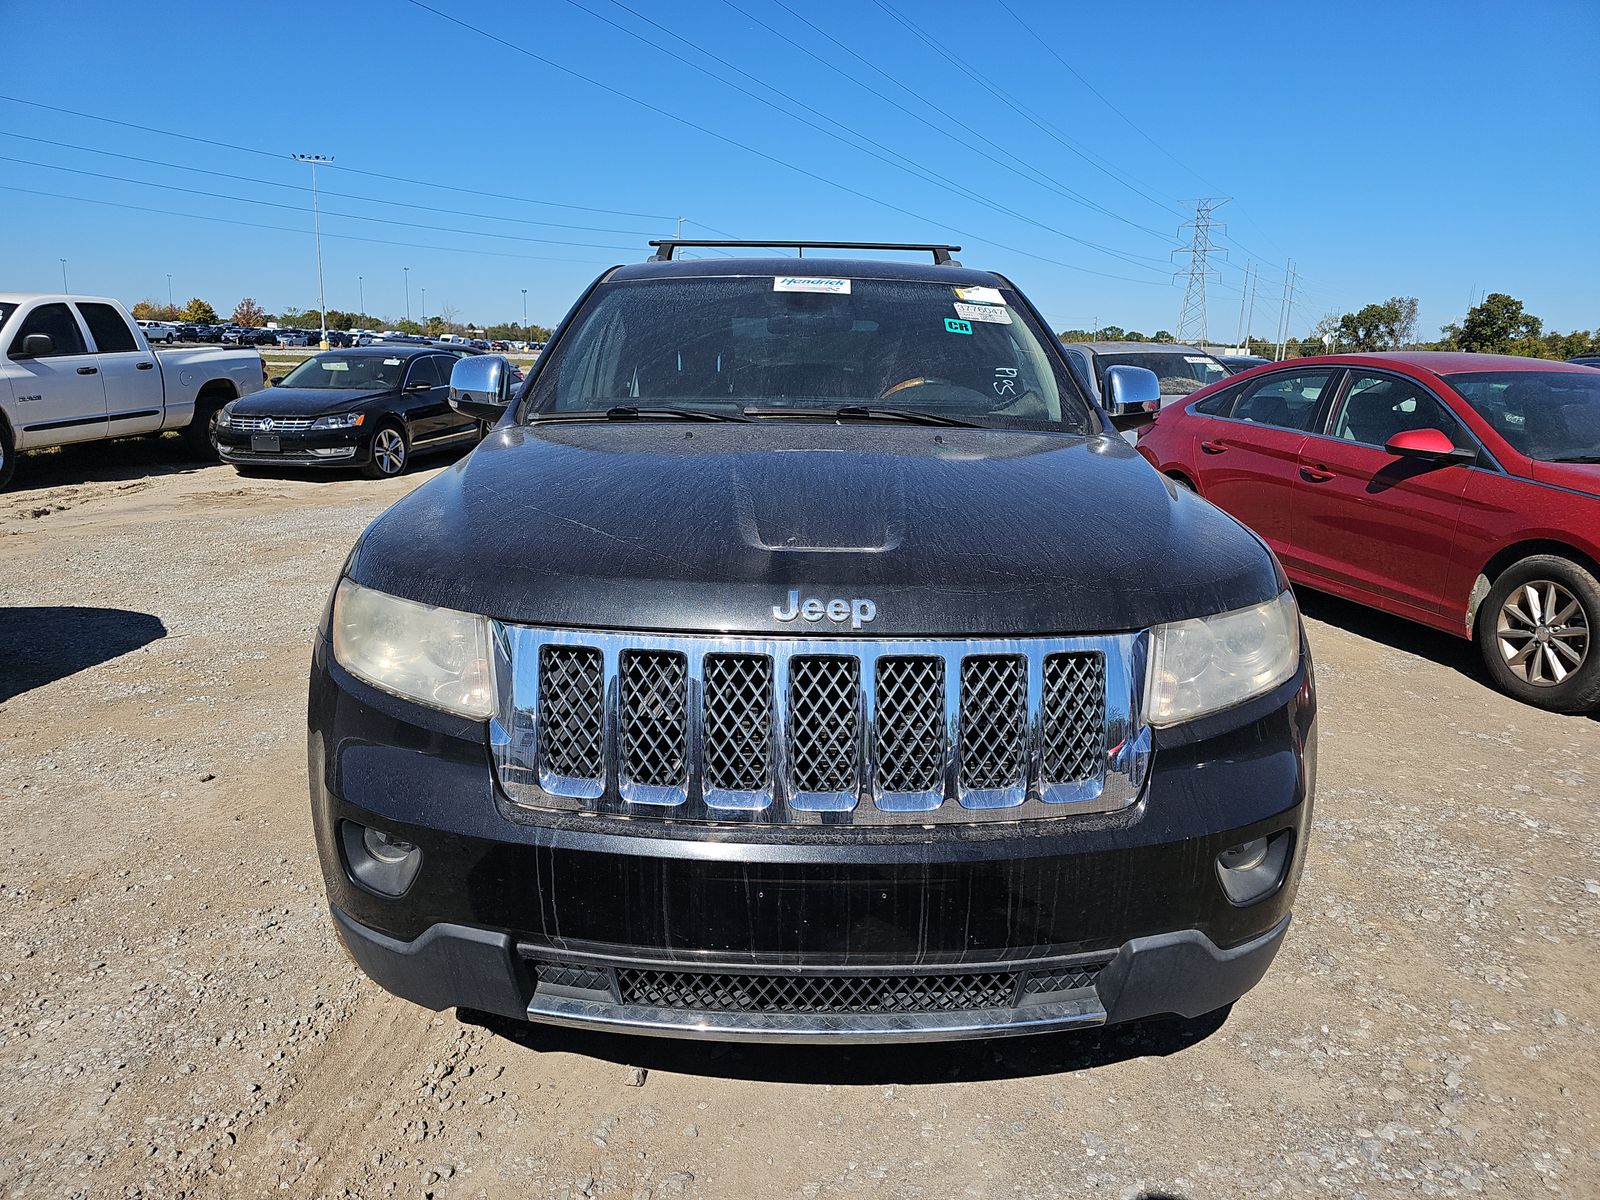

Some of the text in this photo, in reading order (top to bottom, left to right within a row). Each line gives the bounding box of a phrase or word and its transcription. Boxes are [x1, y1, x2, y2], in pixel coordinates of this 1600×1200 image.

[780, 278, 845, 286] Hendrick
[947, 321, 970, 332] CR
[773, 591, 877, 629] Jeep
